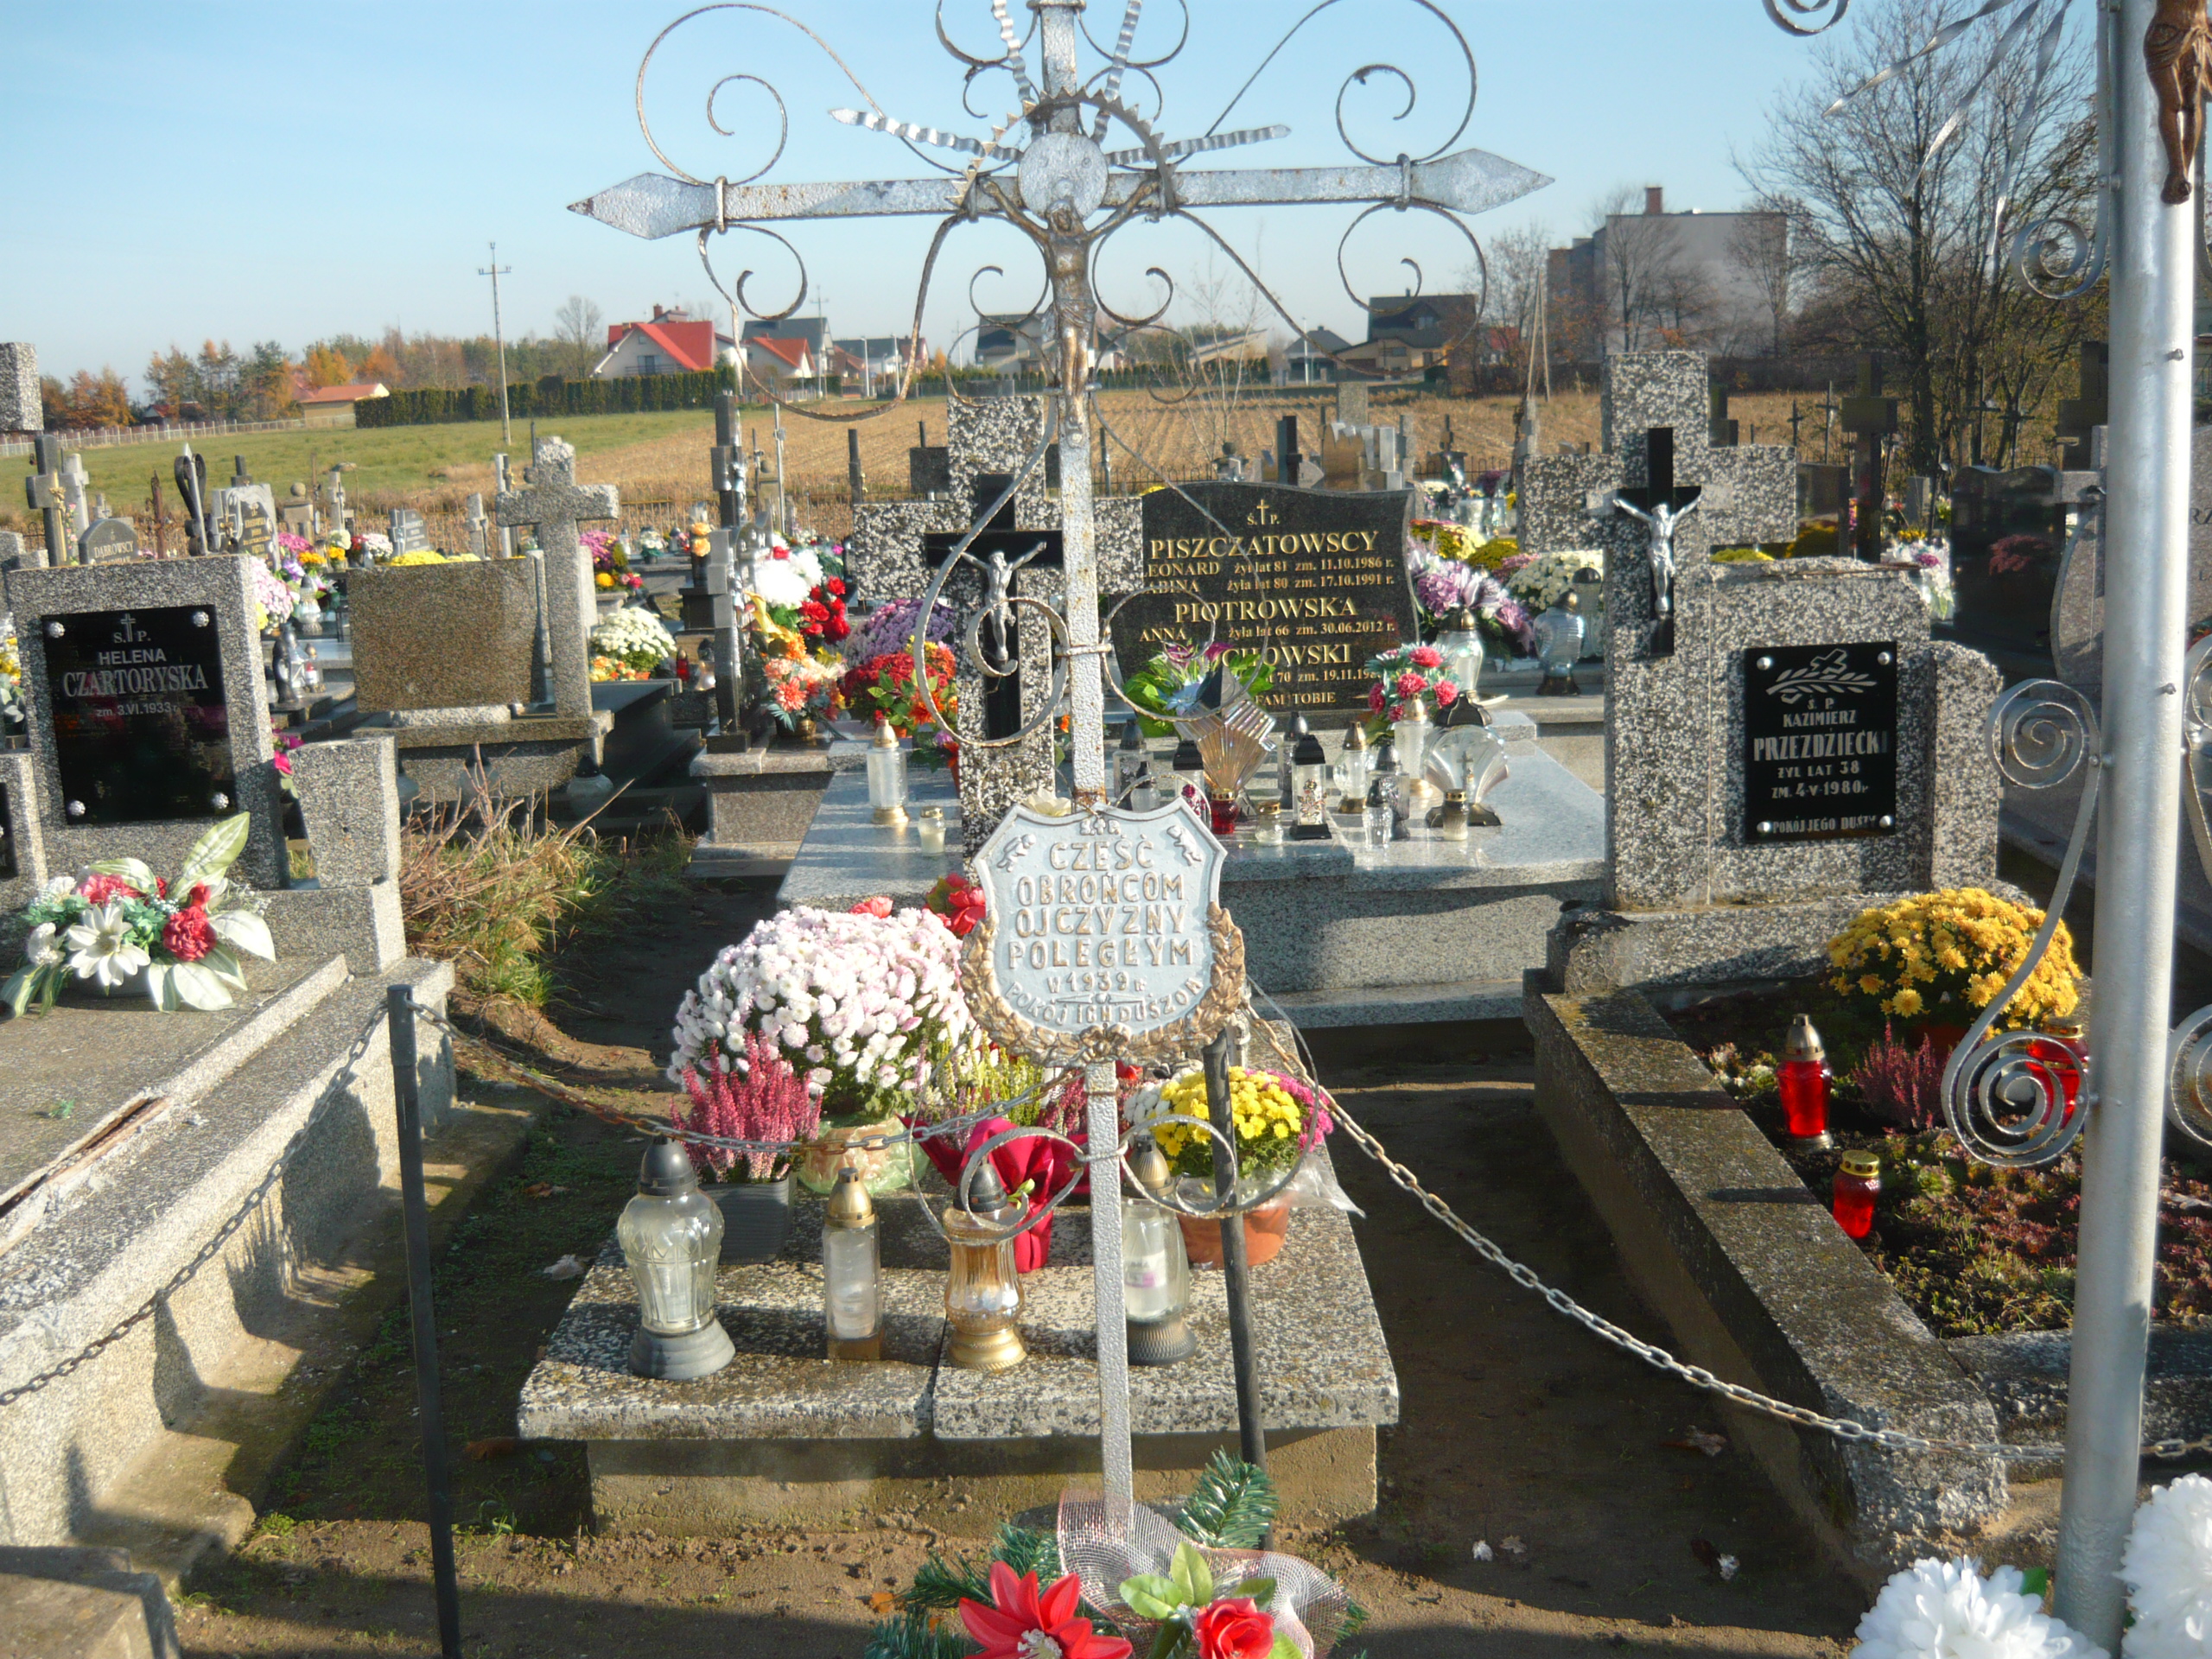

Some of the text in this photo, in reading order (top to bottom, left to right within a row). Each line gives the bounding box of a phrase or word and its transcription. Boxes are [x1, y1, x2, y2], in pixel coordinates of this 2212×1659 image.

[1150, 530, 1380, 560] PISZCZATOWSCY
[1142, 562, 1220, 578] EONARD
[1255, 561, 1271, 573] lat
[1274, 560, 1287, 572] 81
[1294, 562, 1318, 572] zm.
[1320, 556, 1382, 570] 11.10.1986
[1385, 557, 1395, 568] r.
[1274, 576, 1288, 589] 80
[1294, 578, 1318, 588] zm.
[1320, 573, 1382, 588] 17.10.1991
[1385, 575, 1395, 585] r.
[1175, 595, 1359, 623] PIOTROWSKA
[1139, 626, 1187, 642] ANNA
[1274, 624, 1290, 636] 66
[1296, 625, 1318, 635] zm.
[1320, 620, 1383, 634] 30.06.2012
[1386, 621, 1395, 632] r.
[99, 648, 167, 665] HELENA
[63, 664, 209, 698] CZARTORYSKA
[1298, 671, 1319, 683] zm.
[1293, 692, 1337, 705] TOBIE
[1783, 709, 1857, 728] KAZIMIERZ
[1808, 765, 1832, 777] LAT
[1839, 760, 1860, 775] 38
[1807, 817, 1836, 832] JEGO
[1049, 833, 1154, 871] CZEŚĆ
[1017, 871, 1185, 906] OBROŃCOM
[1015, 905, 1186, 938] OJCZYZNY
[1008, 938, 1193, 969] POLEGŁYM
[1066, 971, 1130, 992] 1939
[1004, 980, 1068, 1027] POKÓJ
[1077, 1003, 1112, 1023] ICH
